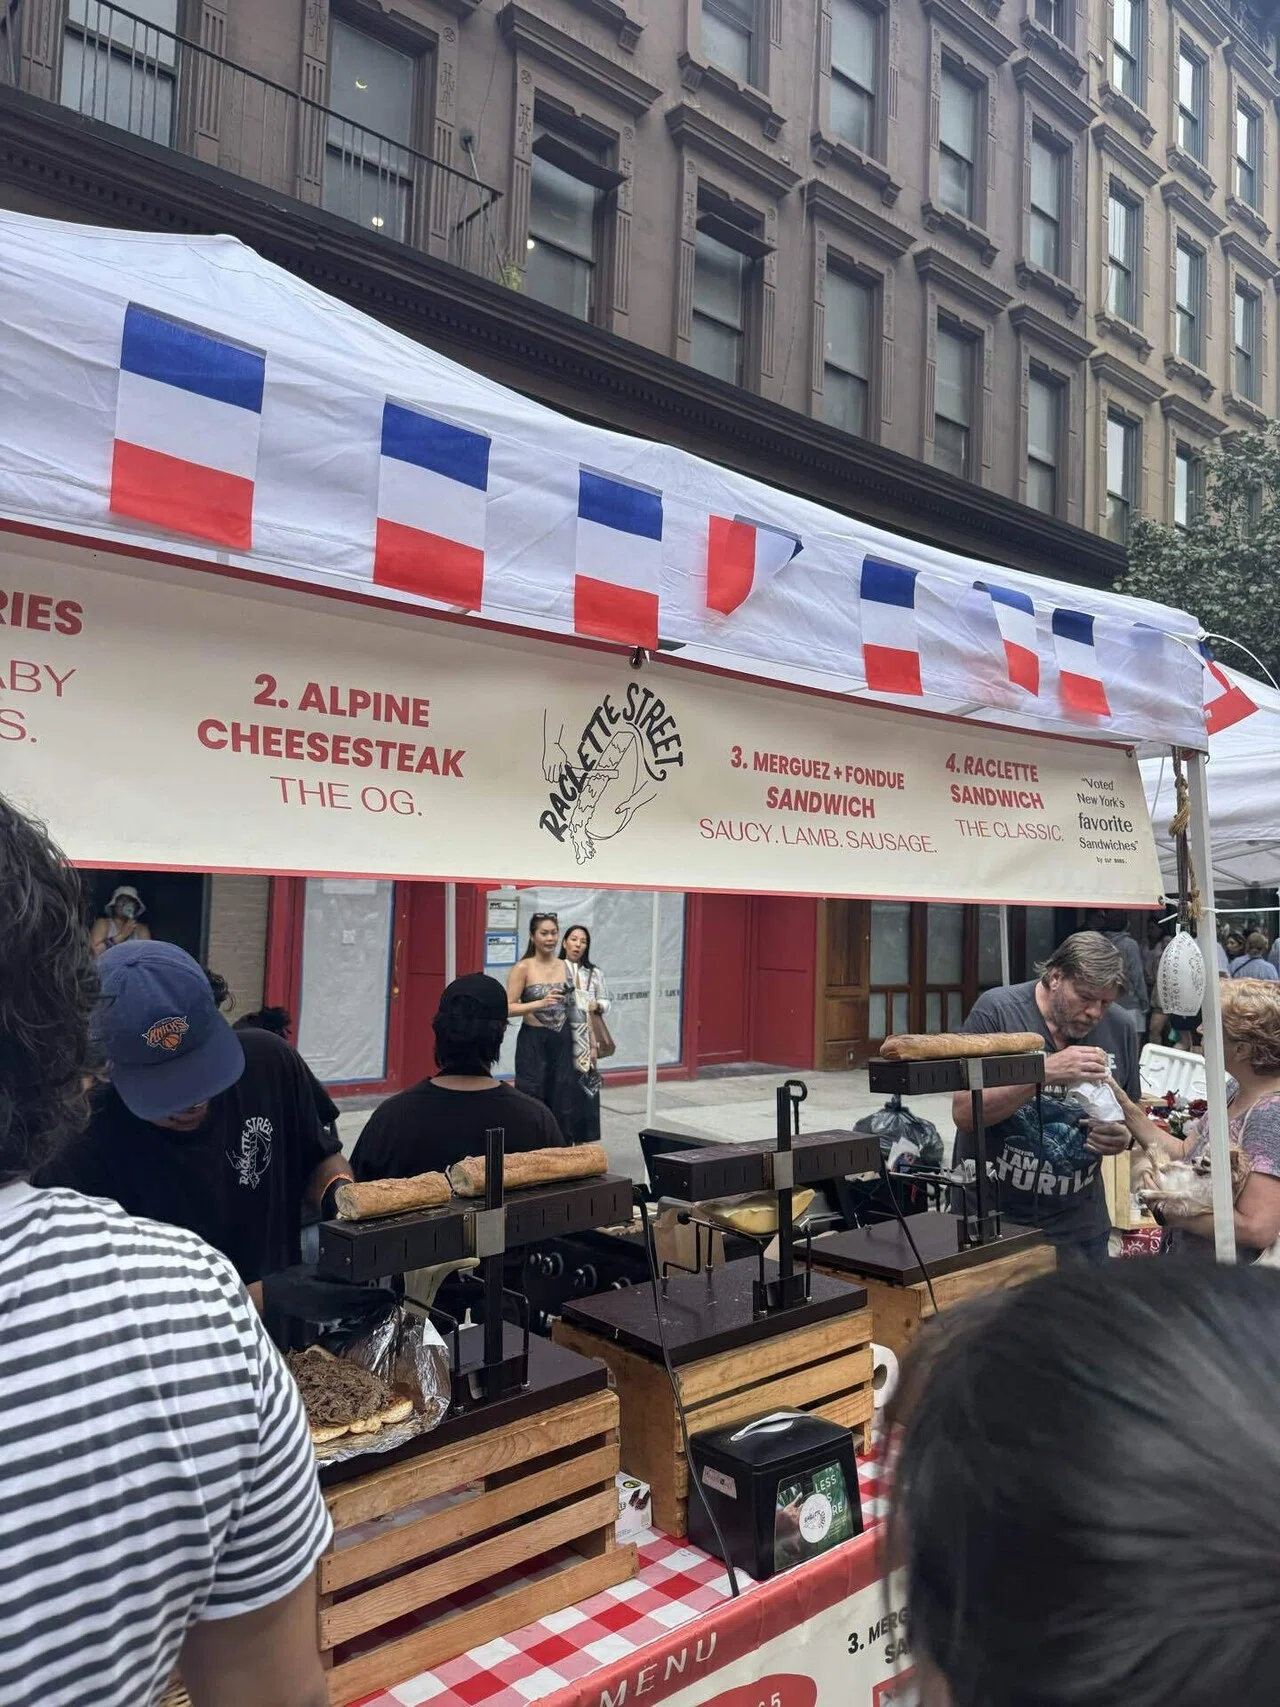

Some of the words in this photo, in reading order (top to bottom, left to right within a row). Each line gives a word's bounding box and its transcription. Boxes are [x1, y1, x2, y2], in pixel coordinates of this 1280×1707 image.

[0, 660, 76, 697] BY
[254, 674, 288, 708] 2.
[299, 682, 430, 727] ALPINE
[623, 683, 683, 766] STREET
[198, 719, 466, 777] CHEESESTEAK
[540, 695, 621, 842] RACLETTE
[730, 745, 748, 769] 3.
[753, 751, 831, 780] MERGUEZ
[834, 768, 842, 780] +
[845, 765, 905, 790] FONDUE
[945, 753, 960, 773] 4.
[964, 755, 1039, 783] RACLETTE
[270, 776, 352, 809] THE
[361, 787, 423, 816] OG.
[766, 786, 876, 819] SANDWICH
[950, 783, 1044, 809] SANDWICH
[1077, 792, 1097, 805] New
[1099, 795, 1125, 808] York's
[699, 818, 778, 844] SAUCY.
[782, 825, 843, 848] LAMB.
[846, 830, 937, 853] SAUSAGE.
[955, 819, 991, 838] THE
[993, 821, 1064, 842] CLASSIC.
[1078, 812, 1133, 832] favorite
[1002, 1148, 1009, 1161] I
[1010, 1153, 1039, 1172] AM
[1041, 1160, 1053, 1174] A
[815, 1475, 837, 1493] LESS
[832, 1502, 844, 1516] RE
[848, 1632, 865, 1655] 3.
[600, 1632, 717, 1707] MENU
